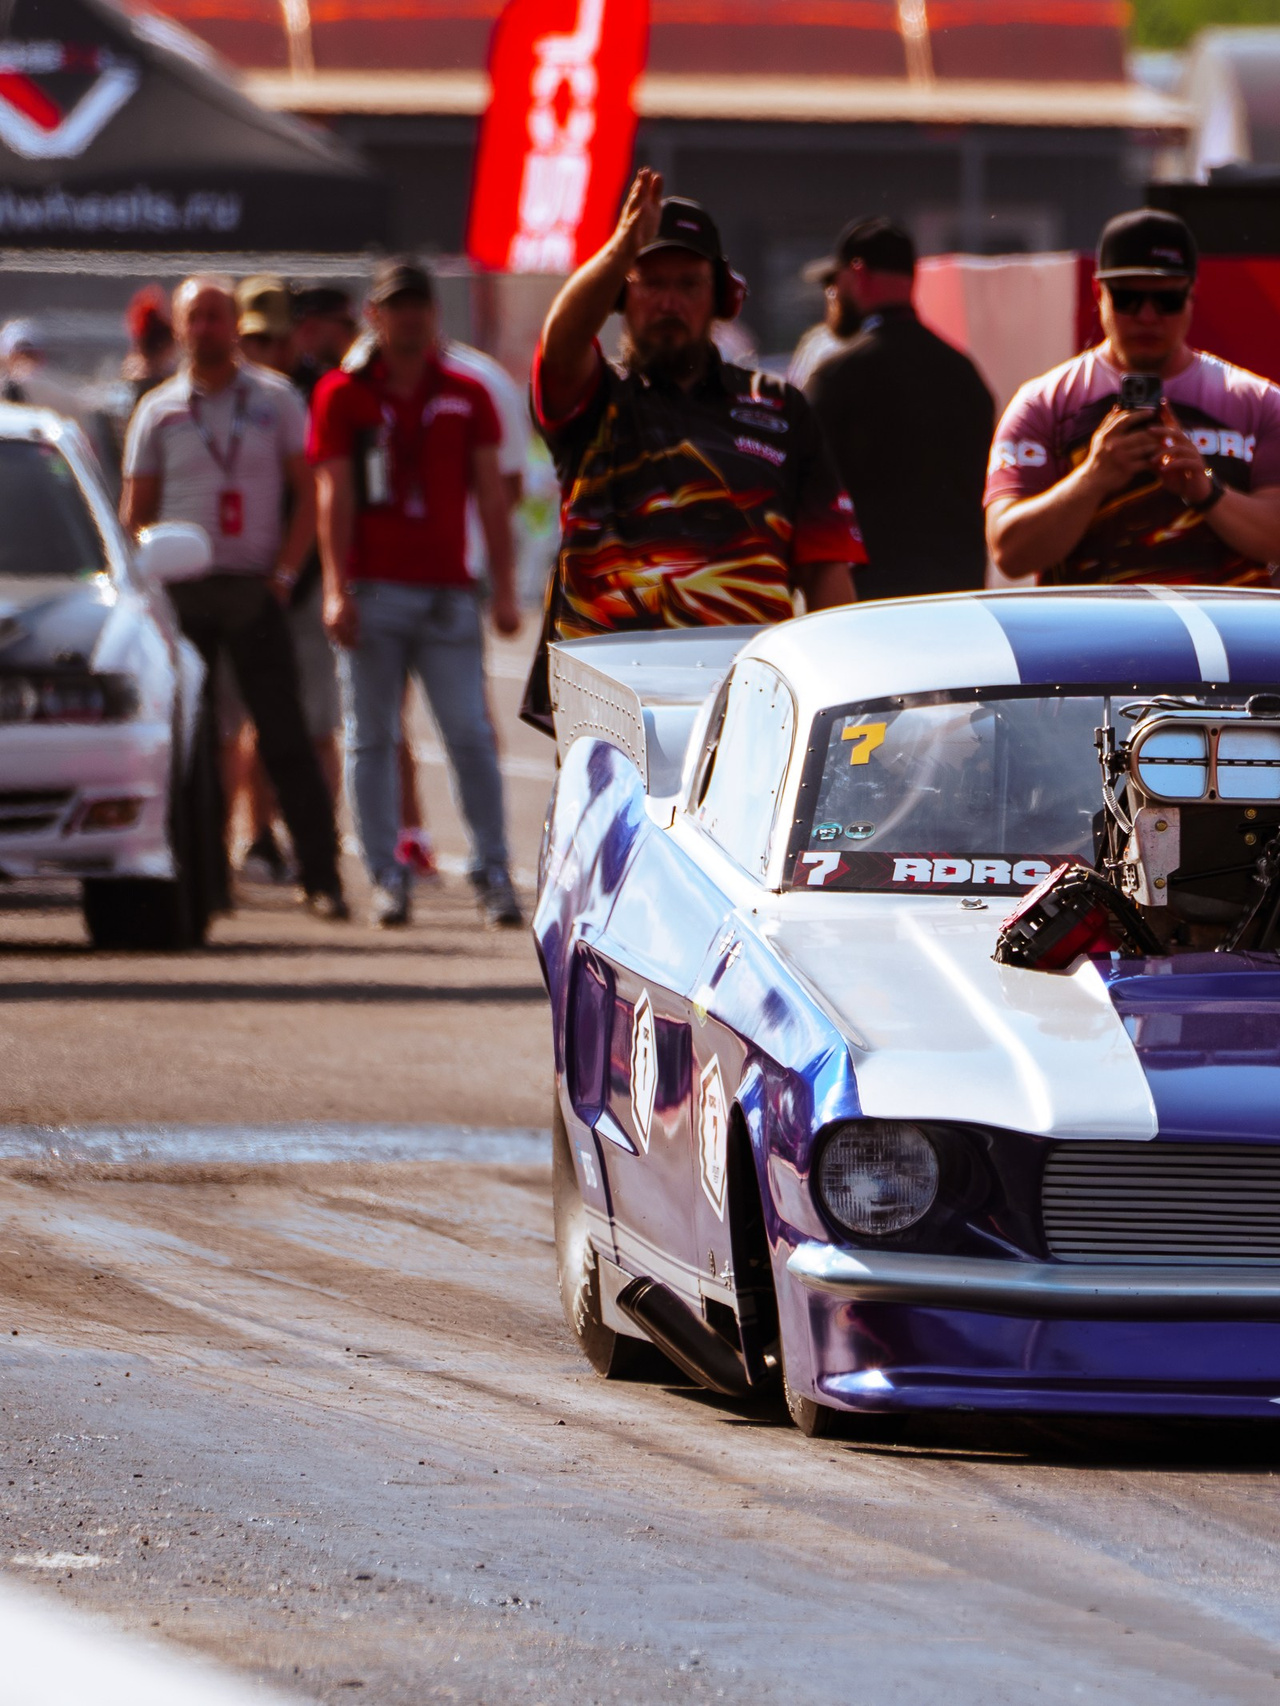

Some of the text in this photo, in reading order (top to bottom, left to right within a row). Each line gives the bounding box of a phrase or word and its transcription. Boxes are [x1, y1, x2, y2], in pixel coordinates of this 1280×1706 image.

[841, 722, 887, 765] 7
[802, 852, 1051, 885] 7 RDRC
